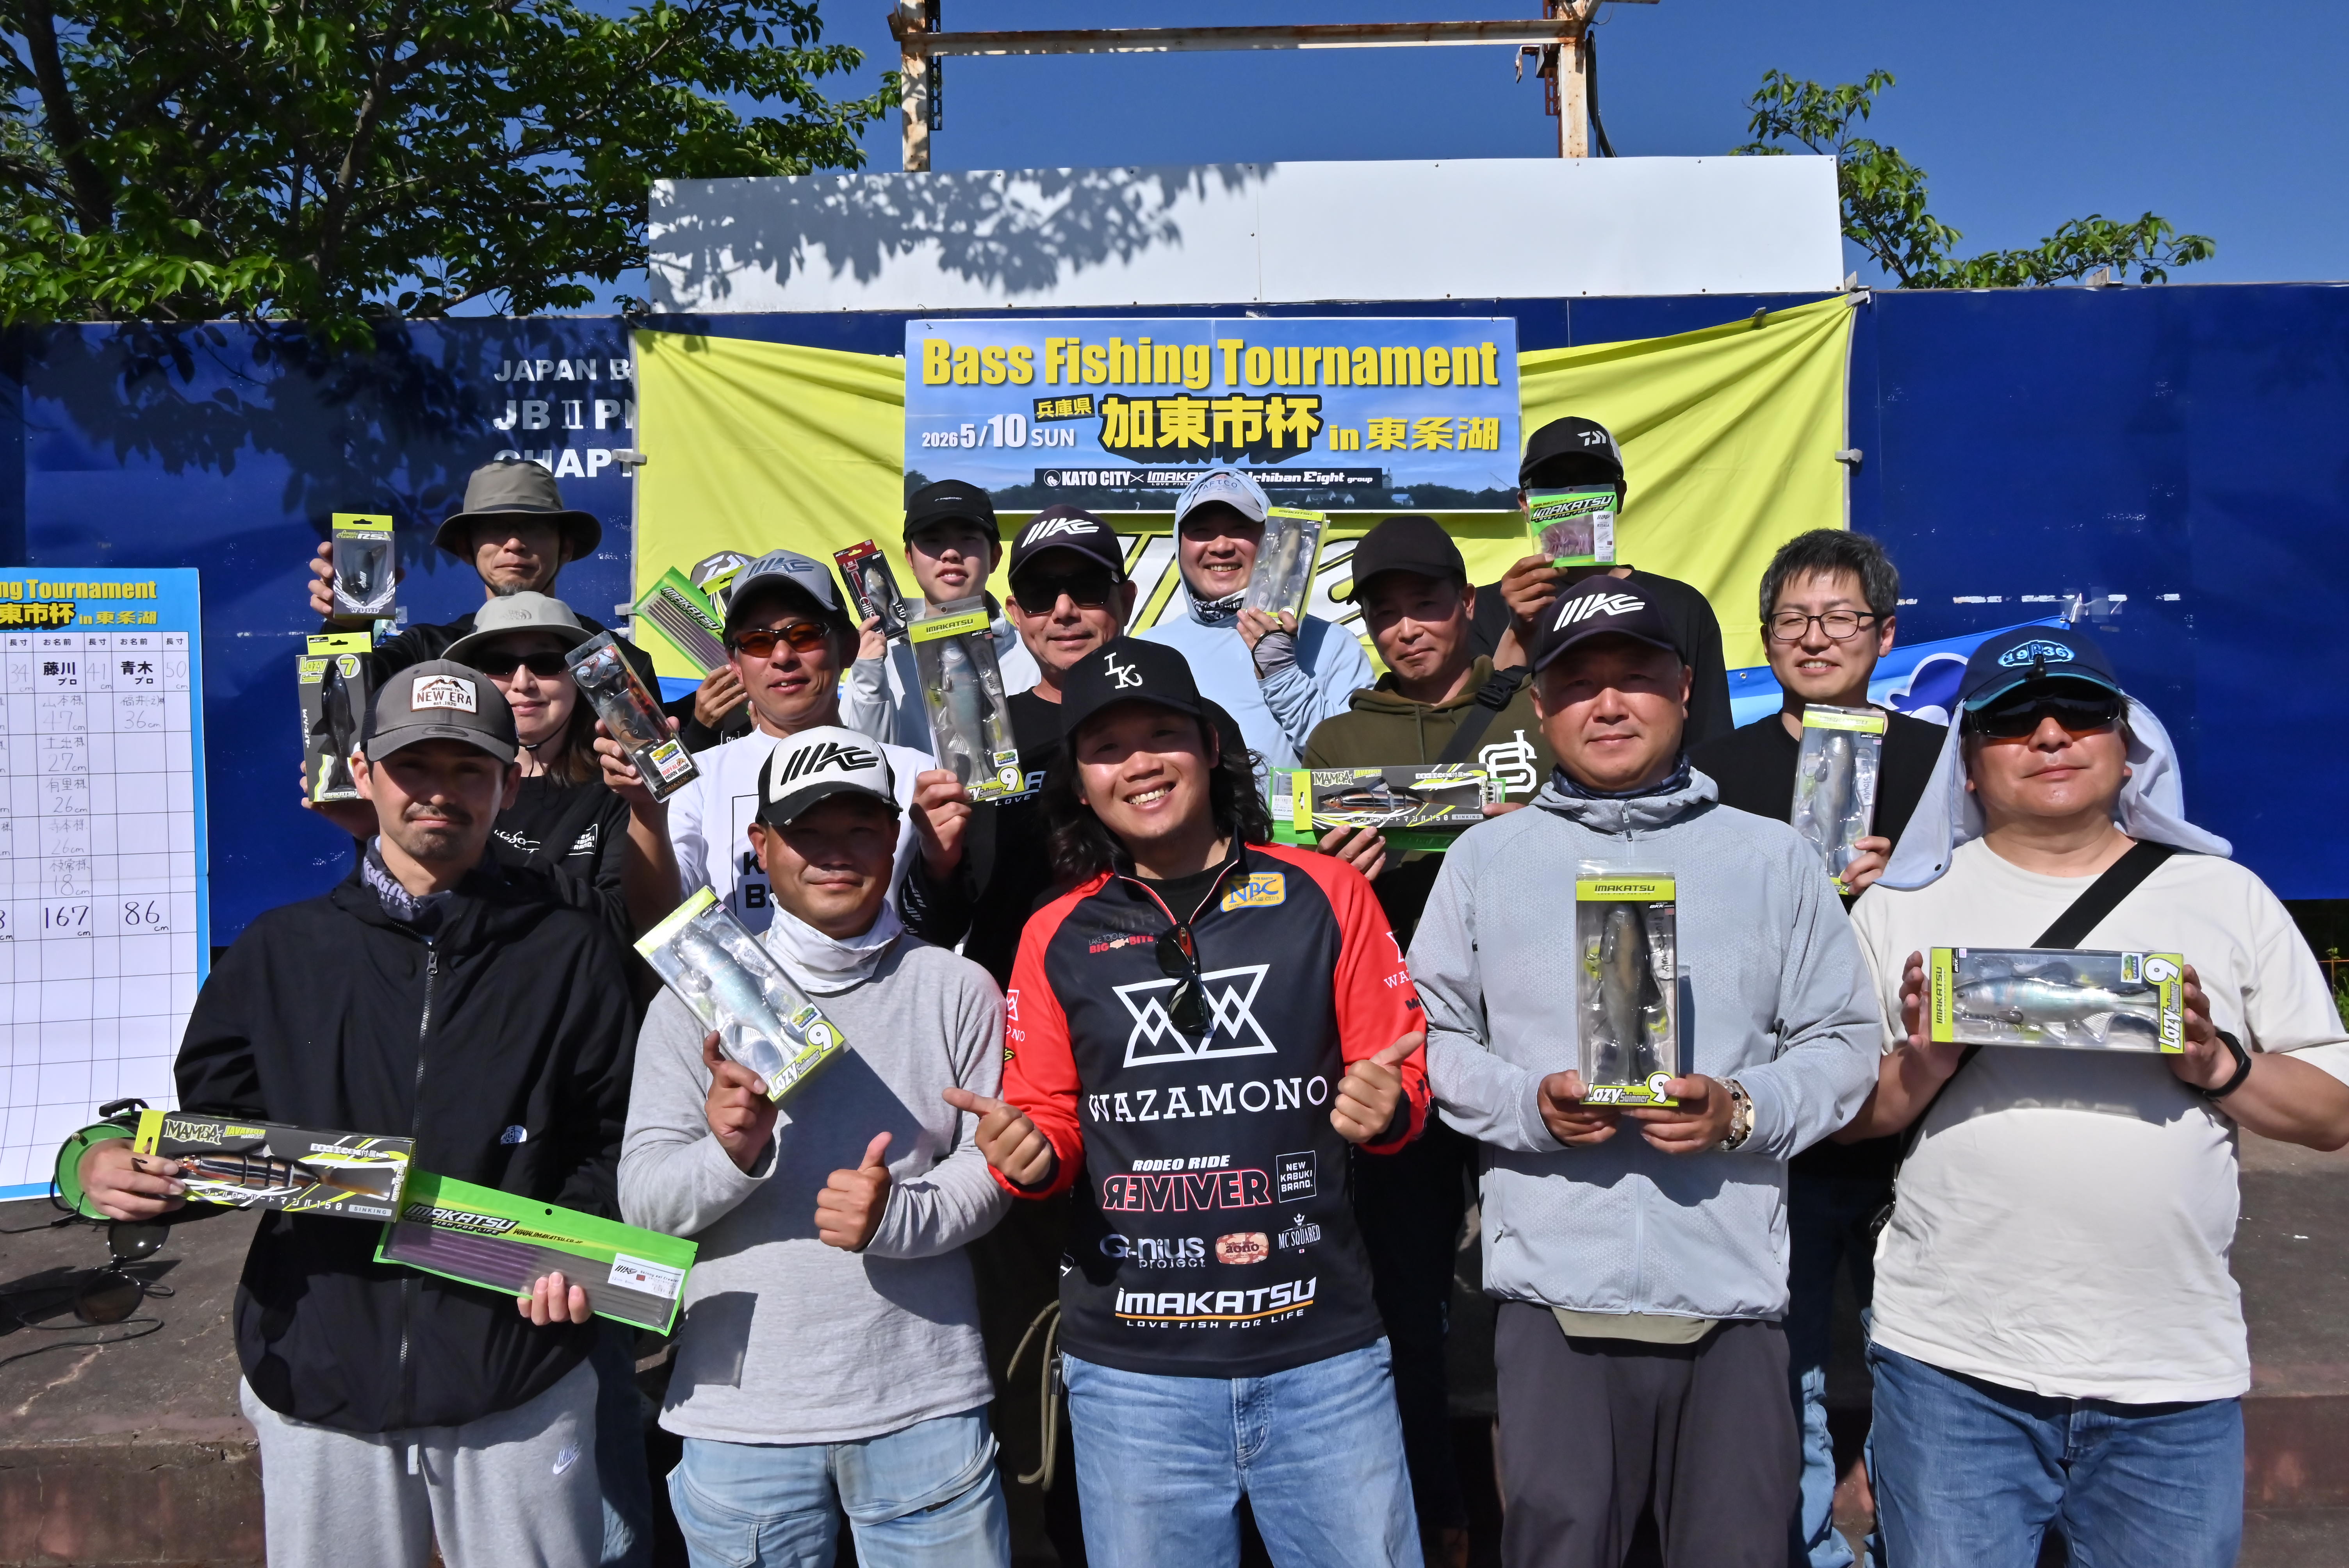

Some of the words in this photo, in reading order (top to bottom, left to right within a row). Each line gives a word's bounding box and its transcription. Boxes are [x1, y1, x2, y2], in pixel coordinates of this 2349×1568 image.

[494, 359, 597, 381] JAPAN
[923, 339, 1032, 384] Bass
[1045, 337, 1209, 389] Fishing
[1217, 339, 1498, 385] Tournament
[493, 400, 550, 430] JB
[1036, 397, 1092, 419] 兵庫県
[922, 432, 958, 447] 2026
[961, 414, 1027, 448] 5/10
[1031, 429, 1074, 447] SUN
[1102, 397, 1320, 448] 加東市杯
[1329, 425, 1359, 450] in
[1365, 417, 1498, 450] 東条湖
[1062, 471, 1098, 486] KATO
[1100, 471, 1131, 486] CITY
[1303, 471, 1345, 485] Eight
[1347, 476, 1373, 484] group
[1203, 479, 1237, 490] AFTCO
[1533, 496, 1613, 518] IMAKATSU
[26, 579, 157, 599] Tournament
[79, 614, 93, 625] in
[96, 611, 157, 625] 東条湖
[662, 587, 720, 629] IMAKATSU
[926, 618, 973, 633] IMAKATSU
[43, 661, 76, 676] 藤川
[120, 661, 153, 675] 青木
[300, 657, 327, 673] Lazy
[340, 658, 356, 676] 7
[58, 677, 77, 686] プロ
[135, 676, 154, 685] プロ
[417, 691, 445, 703] NEW
[449, 691, 472, 706] ERA
[664, 770, 679, 781] HORN
[677, 762, 691, 773] HOOK
[1000, 767, 1019, 791] 9
[995, 794, 1031, 806] LOVE
[45, 905, 89, 929] 167
[125, 900, 160, 926] 86
[1089, 936, 1103, 946] LAKE
[1089, 942, 1110, 953] BIG
[1128, 935, 1154, 946] BITE
[2144, 958, 2180, 982] 9
[2168, 982, 2180, 1014] Swimmer
[807, 1023, 833, 1052] 9
[2158, 1007, 2181, 1049] Lazy
[796, 1049, 822, 1075] Swimmer
[768, 1061, 799, 1098] Lazy
[1584, 1083, 1624, 1104] Lazy
[1620, 1092, 1649, 1103] Swimmer
[1649, 1073, 1672, 1103] 9
[1089, 1074, 1328, 1123] WAZAMONO
[1132, 1158, 1184, 1172] RODEO
[1187, 1155, 1230, 1169] RIDE
[1286, 1161, 1306, 1172] NEW
[1280, 1170, 1312, 1183] KABUKI
[1281, 1180, 1313, 1192] BRAND.
[354, 1206, 387, 1215] SINKING
[406, 1203, 517, 1230] IMAKATSU
[1278, 1232, 1290, 1249] MC
[1290, 1224, 1321, 1247] SQUARED
[1225, 1243, 1260, 1254] aono
[1139, 1256, 1206, 1269] project
[1115, 1276, 1317, 1315] IMAKATSU
[1126, 1320, 1169, 1328] LOVE
[1179, 1321, 1219, 1329] FISH
[1229, 1319, 1262, 1329] FOR
[1271, 1308, 1304, 1324] LIFE
